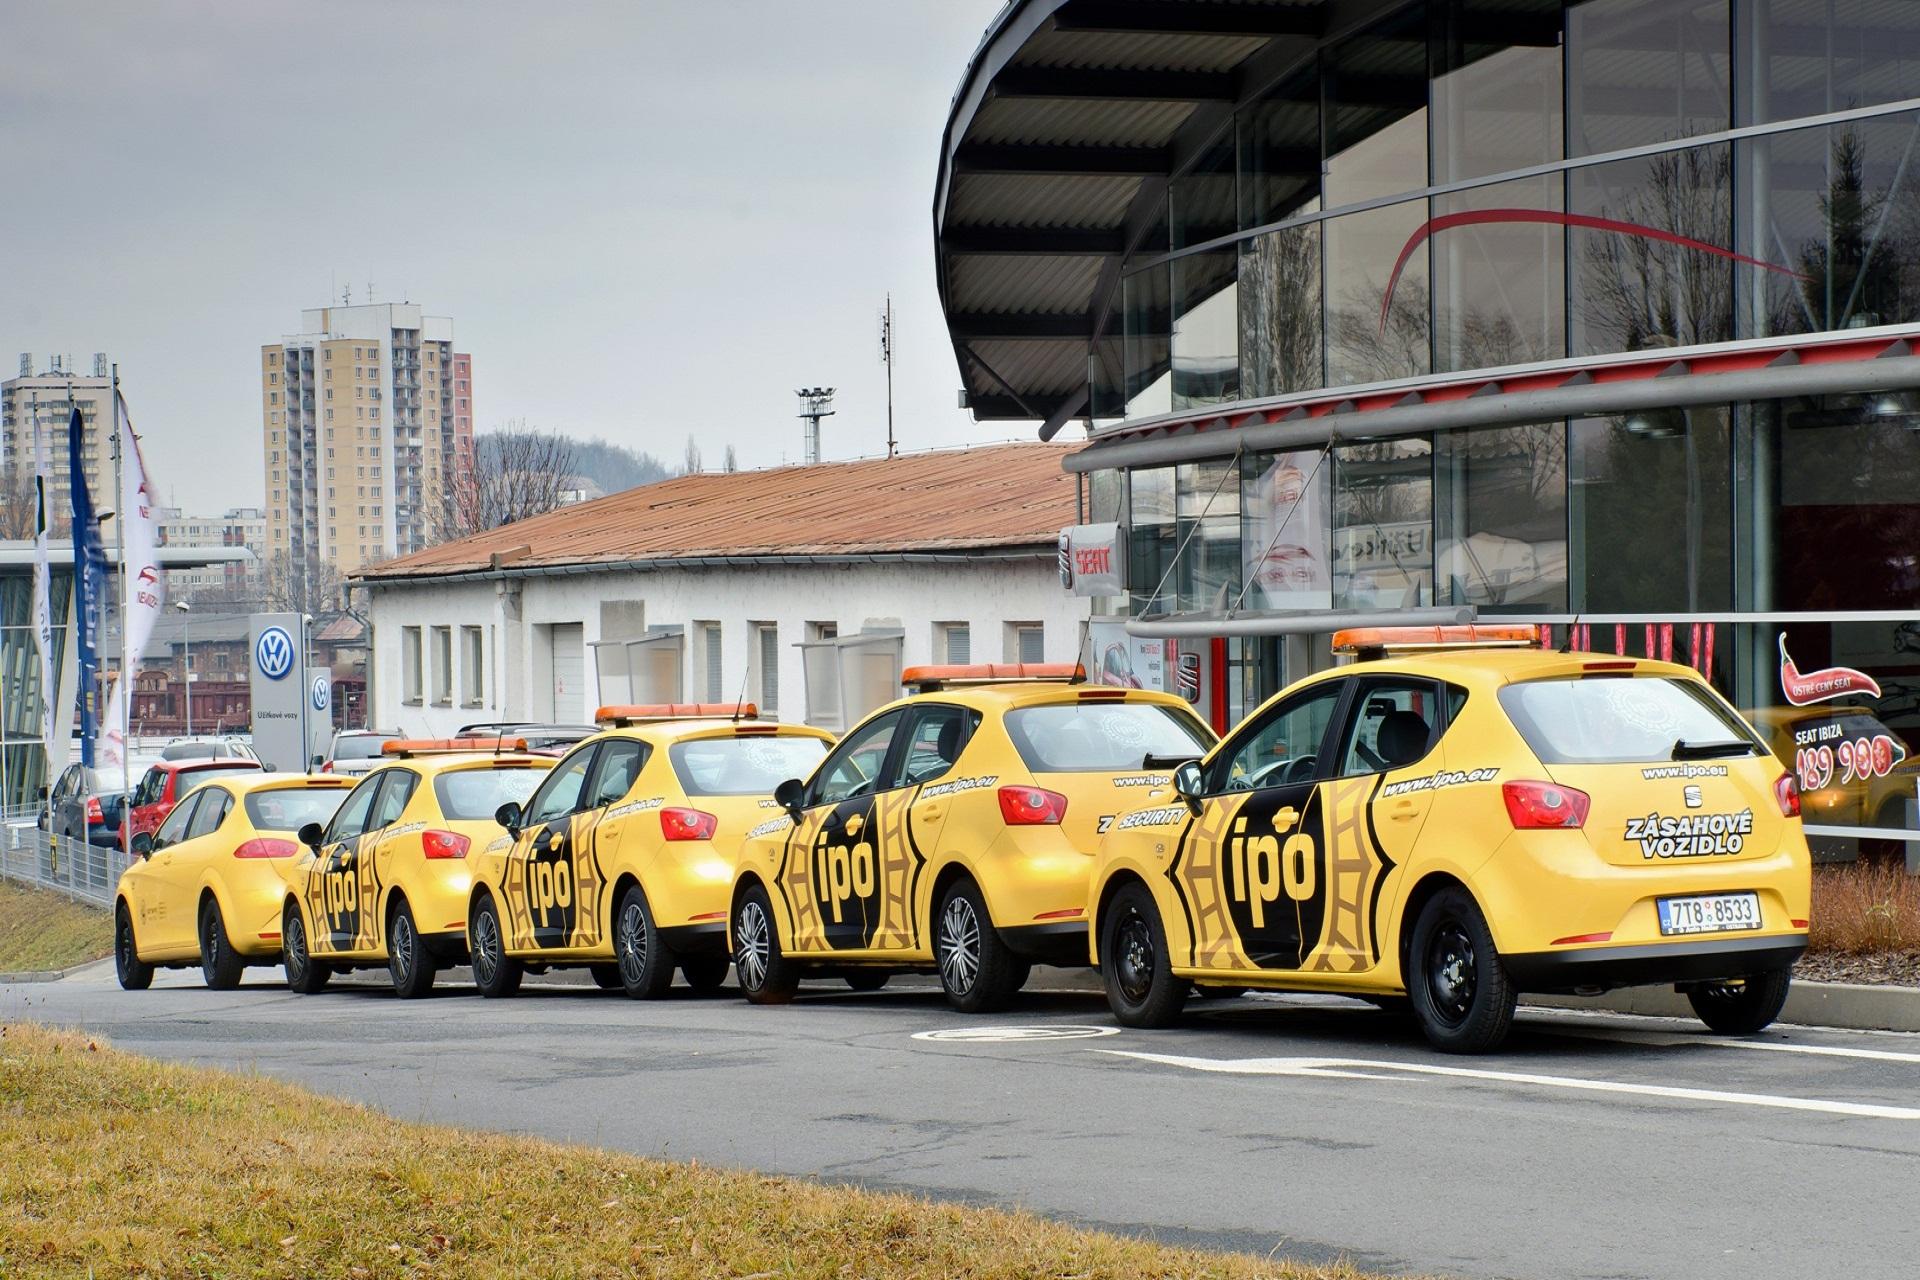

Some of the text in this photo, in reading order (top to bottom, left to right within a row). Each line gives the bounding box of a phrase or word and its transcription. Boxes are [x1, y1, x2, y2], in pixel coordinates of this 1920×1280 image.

[1075, 547, 1110, 575] SEAT
[1815, 680, 1834, 693] CENY
[1834, 677, 1852, 690] SEAT
[284, 712, 298, 720] vozy
[1795, 723, 1843, 745] SEAT IBIZA
[1642, 764, 1728, 780] www.ipo.eu
[1796, 735, 1893, 791] 189 900
[921, 775, 999, 799] www.ipo.eu
[1113, 774, 1171, 788] www.ipo
[1382, 768, 1500, 798] www.ipo.eu
[1118, 807, 1189, 829] SECURITY
[1624, 807, 1754, 840] ZÁSAHOVÉ
[1640, 834, 1743, 859] VOZIDLO
[817, 831, 874, 923] ipo
[1231, 816, 1316, 929] ipo
[325, 859, 357, 930] ipo
[529, 848, 571, 928] ipo
[1673, 898, 1752, 925] 7T8 8533
